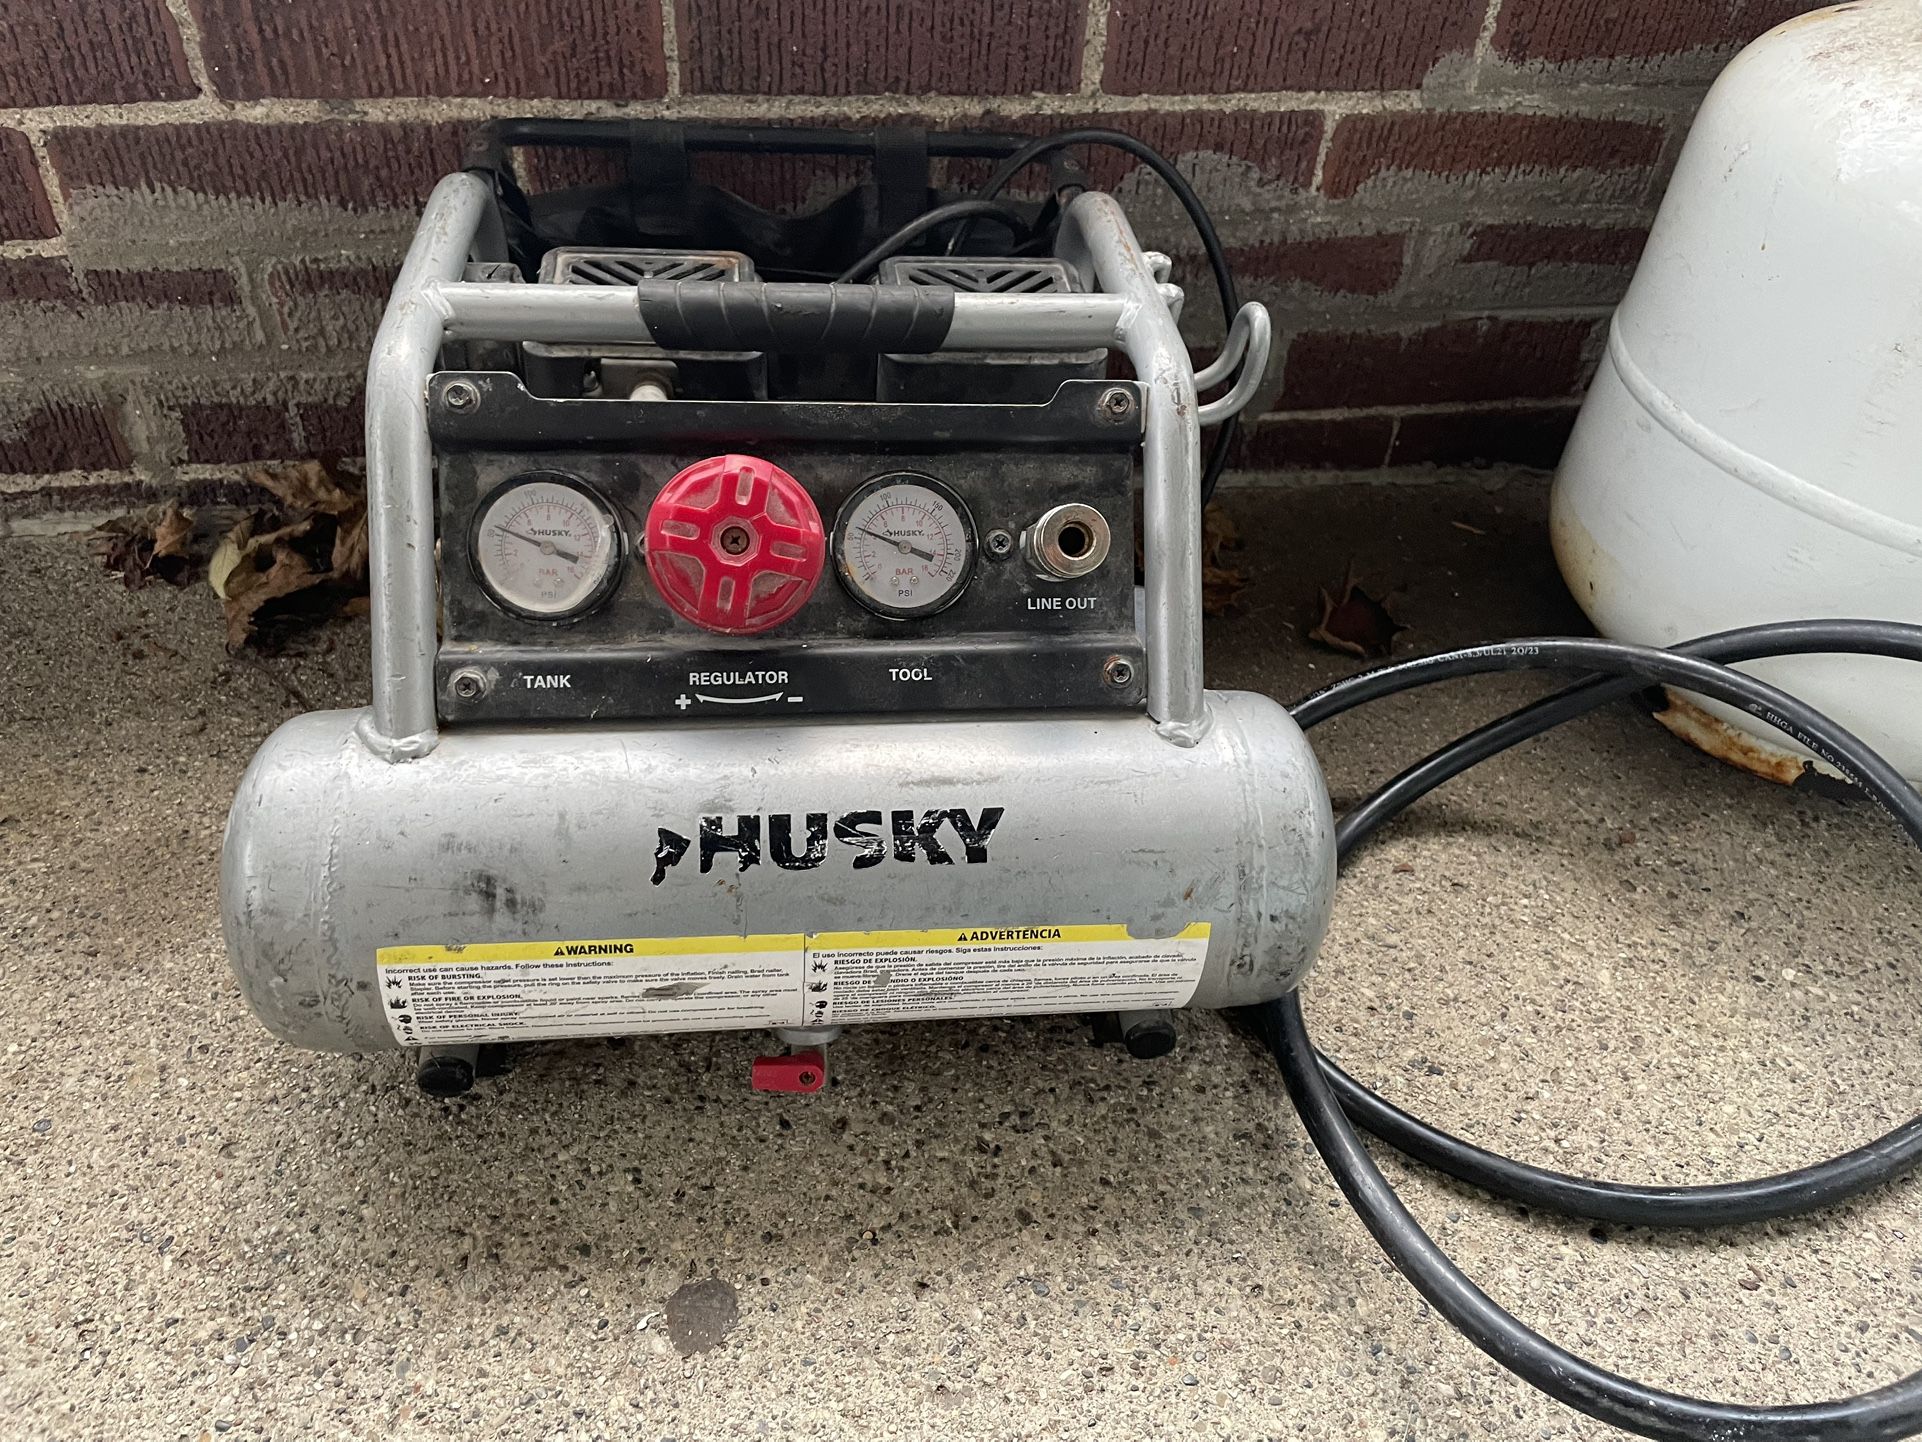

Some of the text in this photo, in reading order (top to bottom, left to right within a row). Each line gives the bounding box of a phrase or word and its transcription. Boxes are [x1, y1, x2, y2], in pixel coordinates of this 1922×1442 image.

[880, 492, 891, 500] 100
[1027, 597, 1097, 610] LINE OUT
[523, 674, 572, 689] TANK
[689, 671, 789, 686] REGULATOR
[889, 668, 933, 681] TOOL
[1797, 731, 1819, 750] FILE
[699, 807, 1005, 874] HUSKY
[970, 928, 1061, 942] ADVERTENCIA
[566, 944, 634, 956] WARNING
